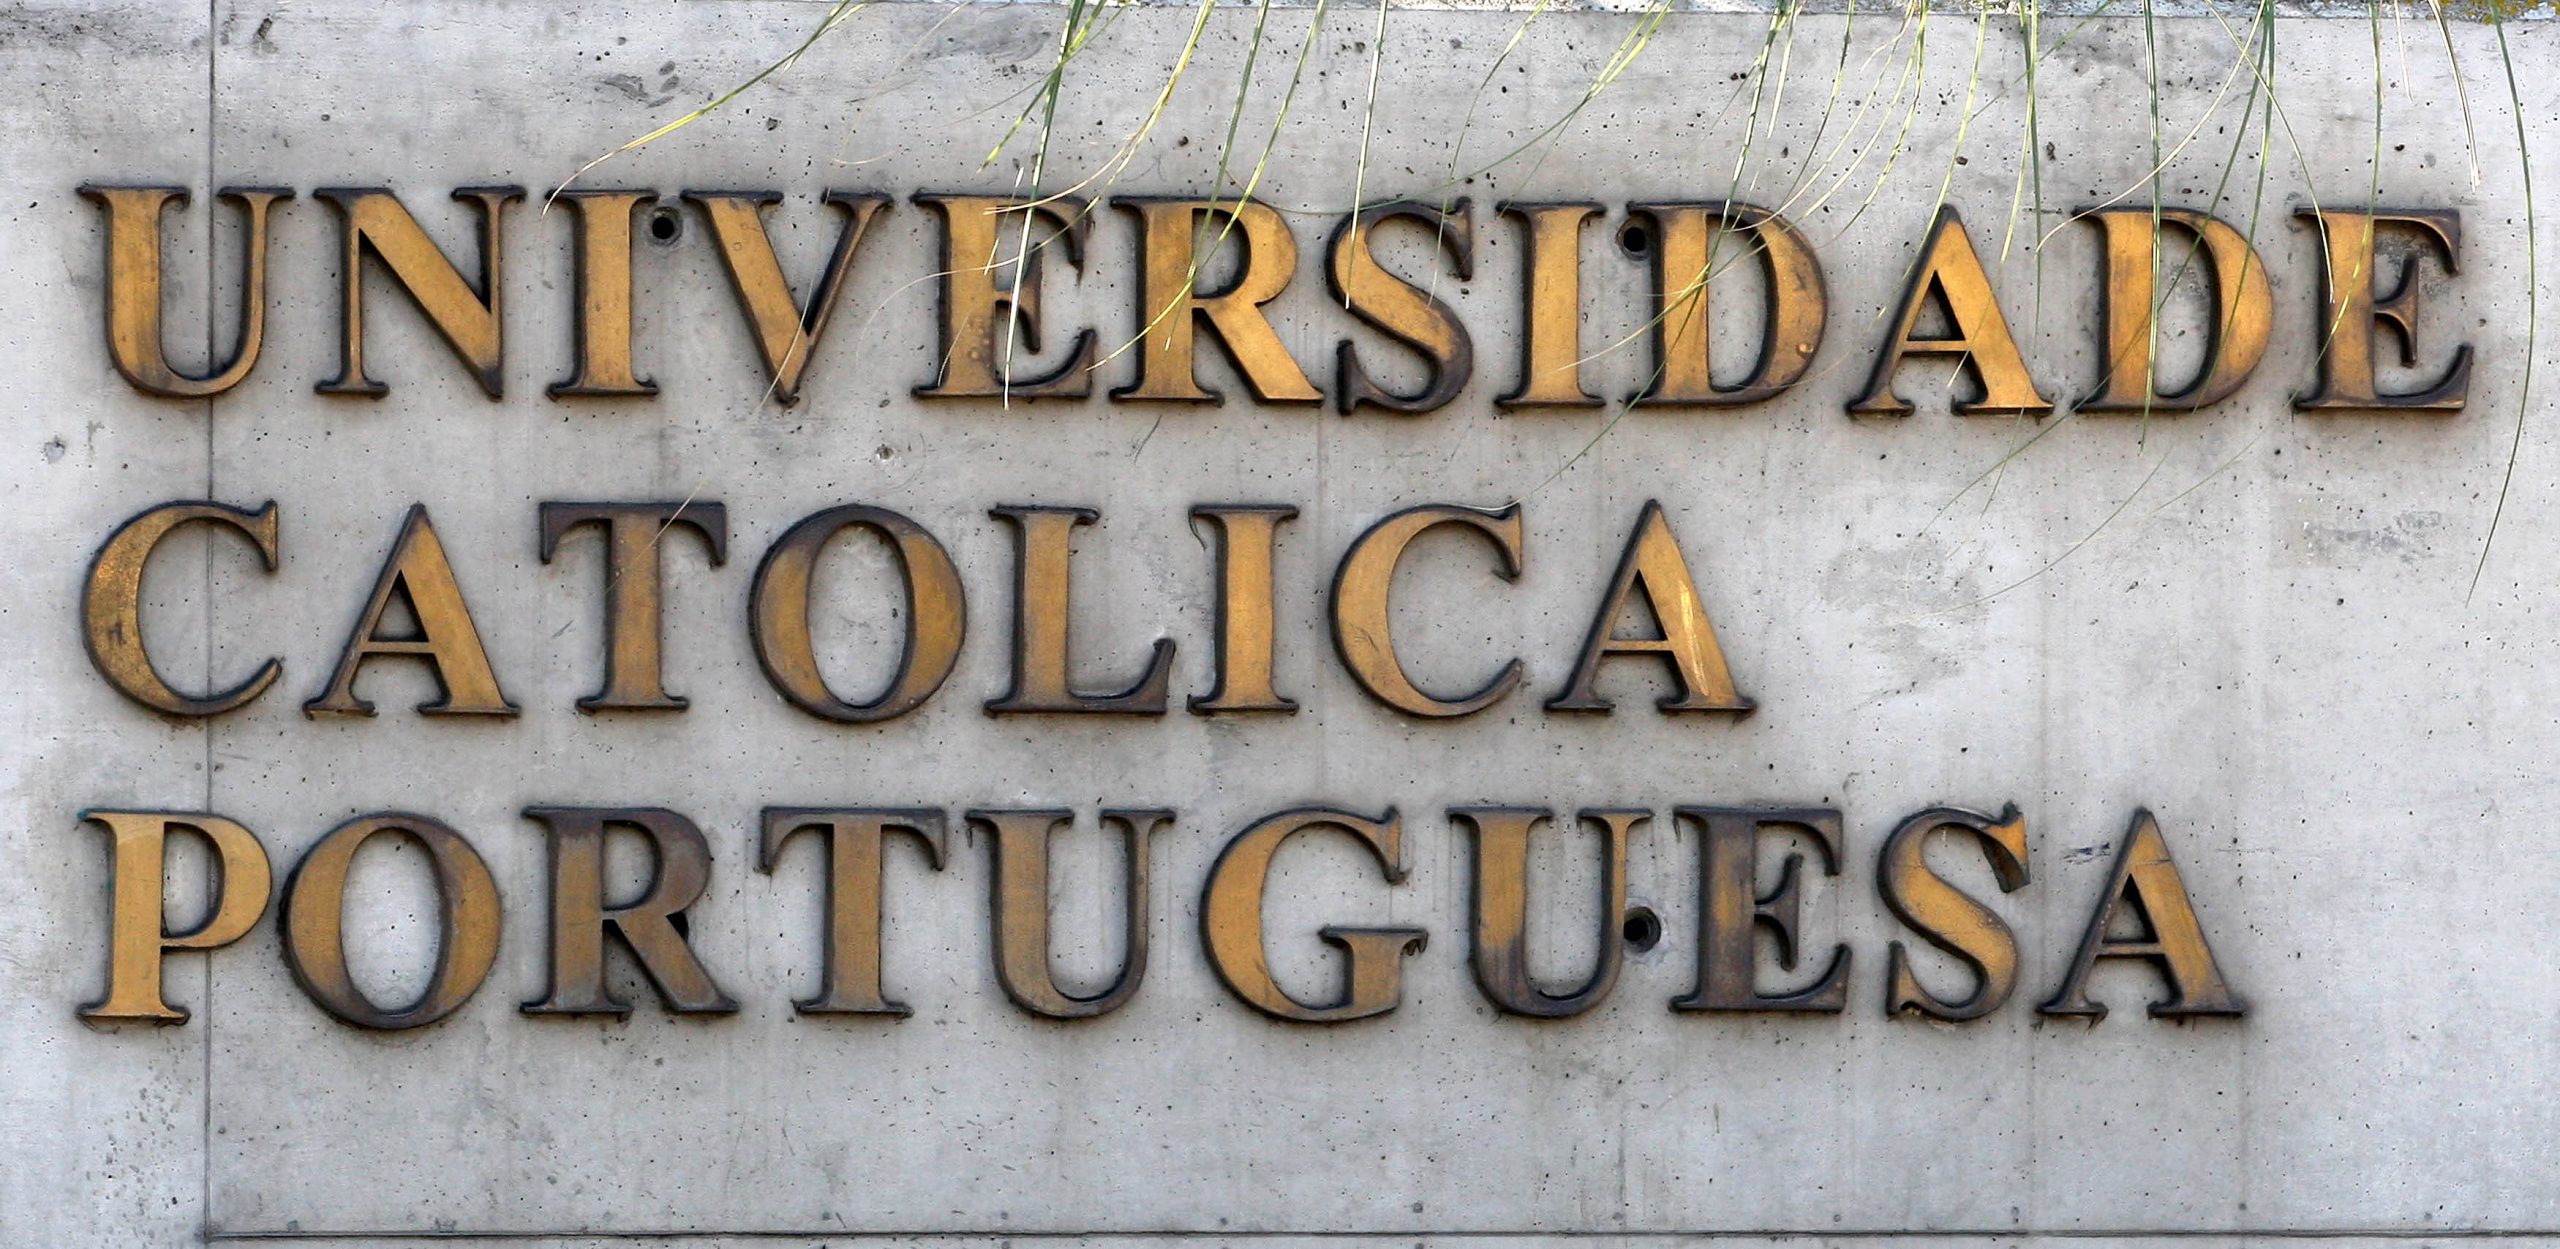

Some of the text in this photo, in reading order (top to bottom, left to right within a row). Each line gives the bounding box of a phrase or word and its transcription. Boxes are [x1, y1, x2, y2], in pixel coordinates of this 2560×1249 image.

[77, 185, 2474, 414] UNIVERSIDADE
[82, 498, 1757, 723] CATOLICA
[76, 802, 2250, 1029] PORTUGUESA
